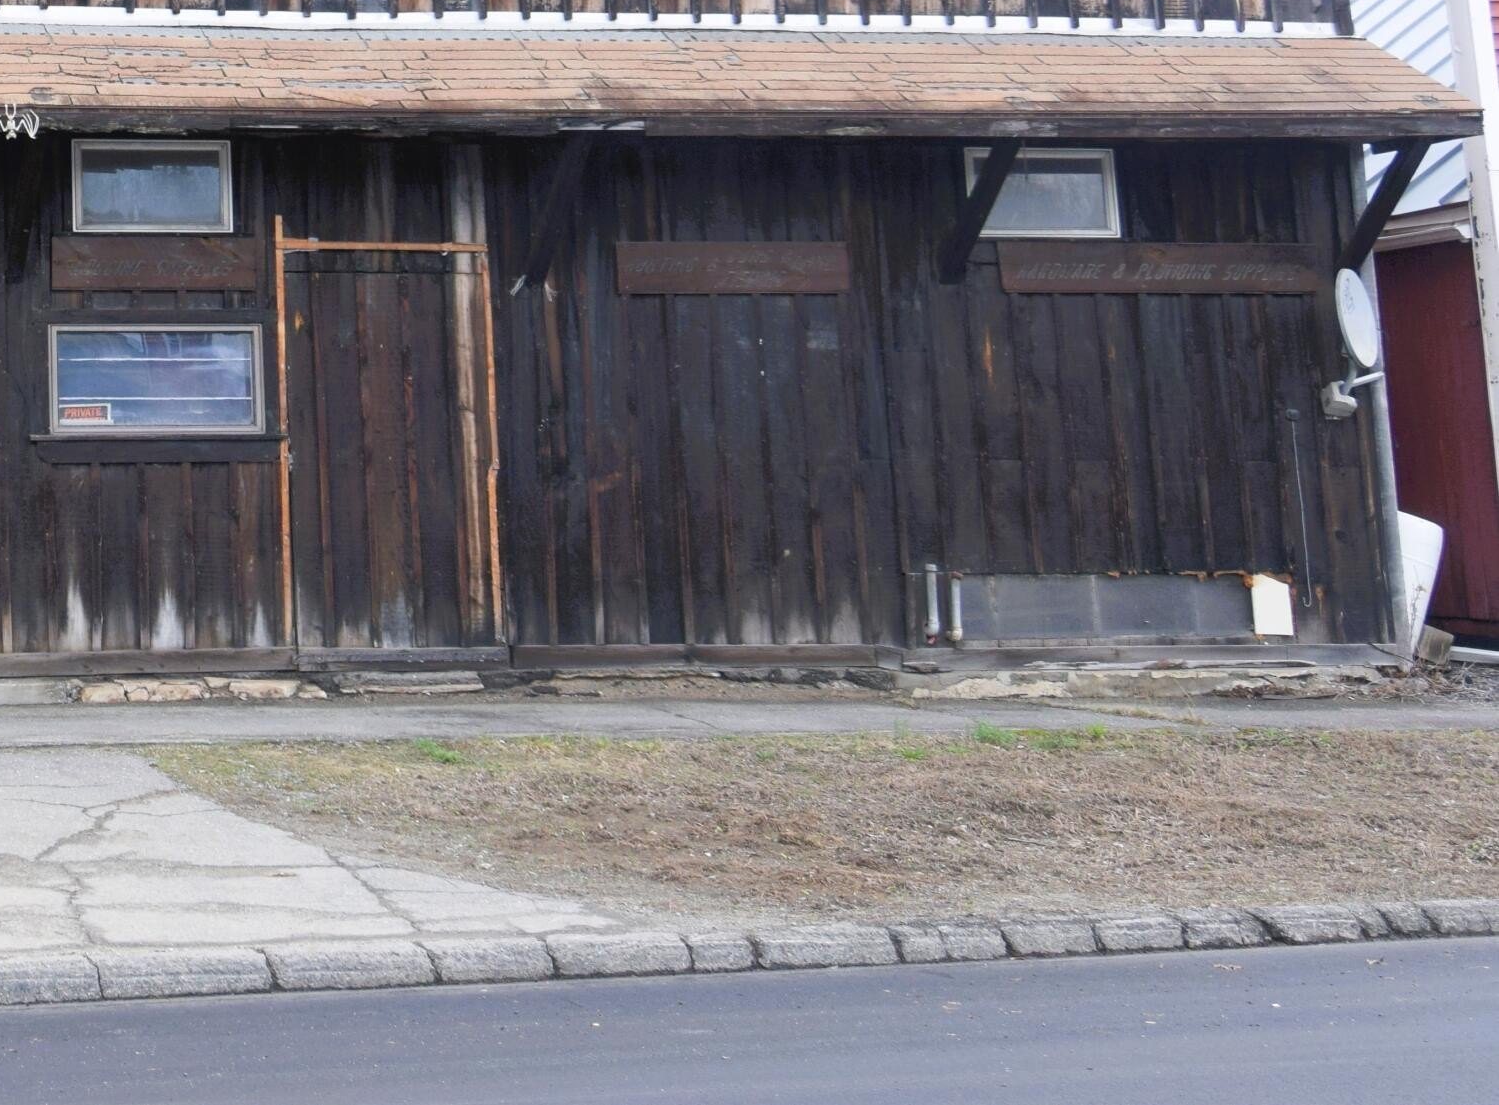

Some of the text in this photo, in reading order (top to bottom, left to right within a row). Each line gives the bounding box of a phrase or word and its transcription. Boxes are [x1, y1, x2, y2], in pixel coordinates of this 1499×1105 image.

[1016, 263, 1107, 280] HARDWARE
[1112, 263, 1126, 280] &
[1134, 263, 1217, 280] PLUMBING
[64, 406, 102, 418] PRIVATE
